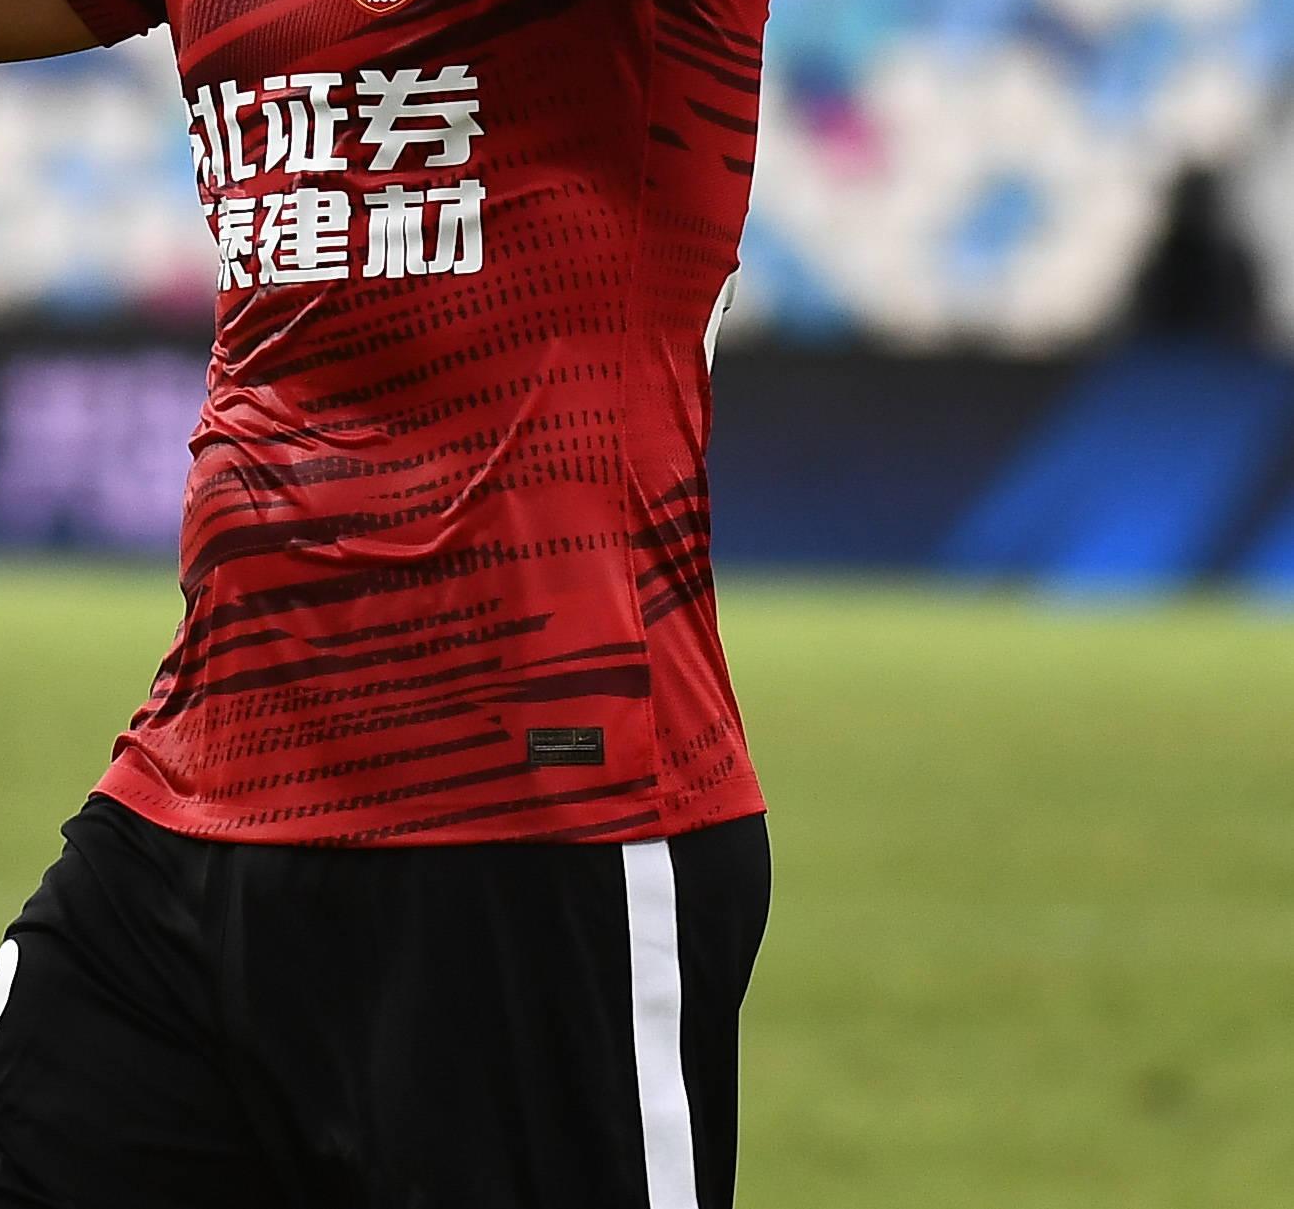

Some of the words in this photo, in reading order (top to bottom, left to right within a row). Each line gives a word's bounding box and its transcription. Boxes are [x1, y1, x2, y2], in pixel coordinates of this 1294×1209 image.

[183, 65, 485, 189] 北证券
[201, 179, 487, 291] 泰建材
